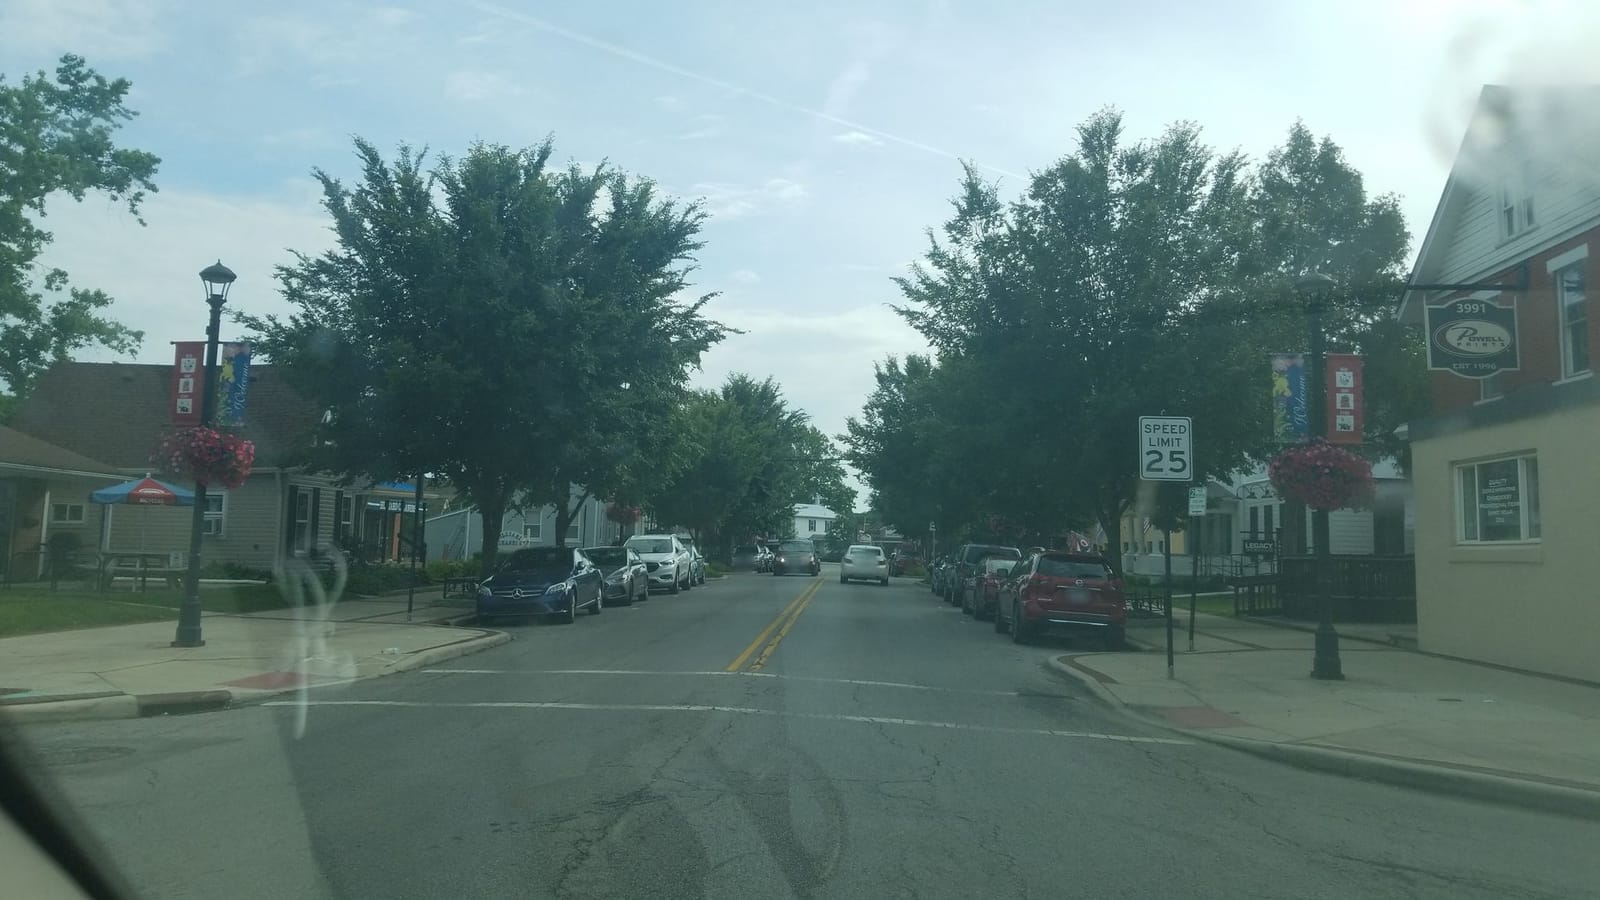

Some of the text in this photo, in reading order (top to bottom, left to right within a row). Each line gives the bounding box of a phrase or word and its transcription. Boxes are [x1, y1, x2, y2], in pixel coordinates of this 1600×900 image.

[1456, 303, 1486, 313] 3991
[1144, 423, 1187, 434] SPEED
[1148, 437, 1182, 447] LIMIT
[1145, 450, 1187, 473] 25
